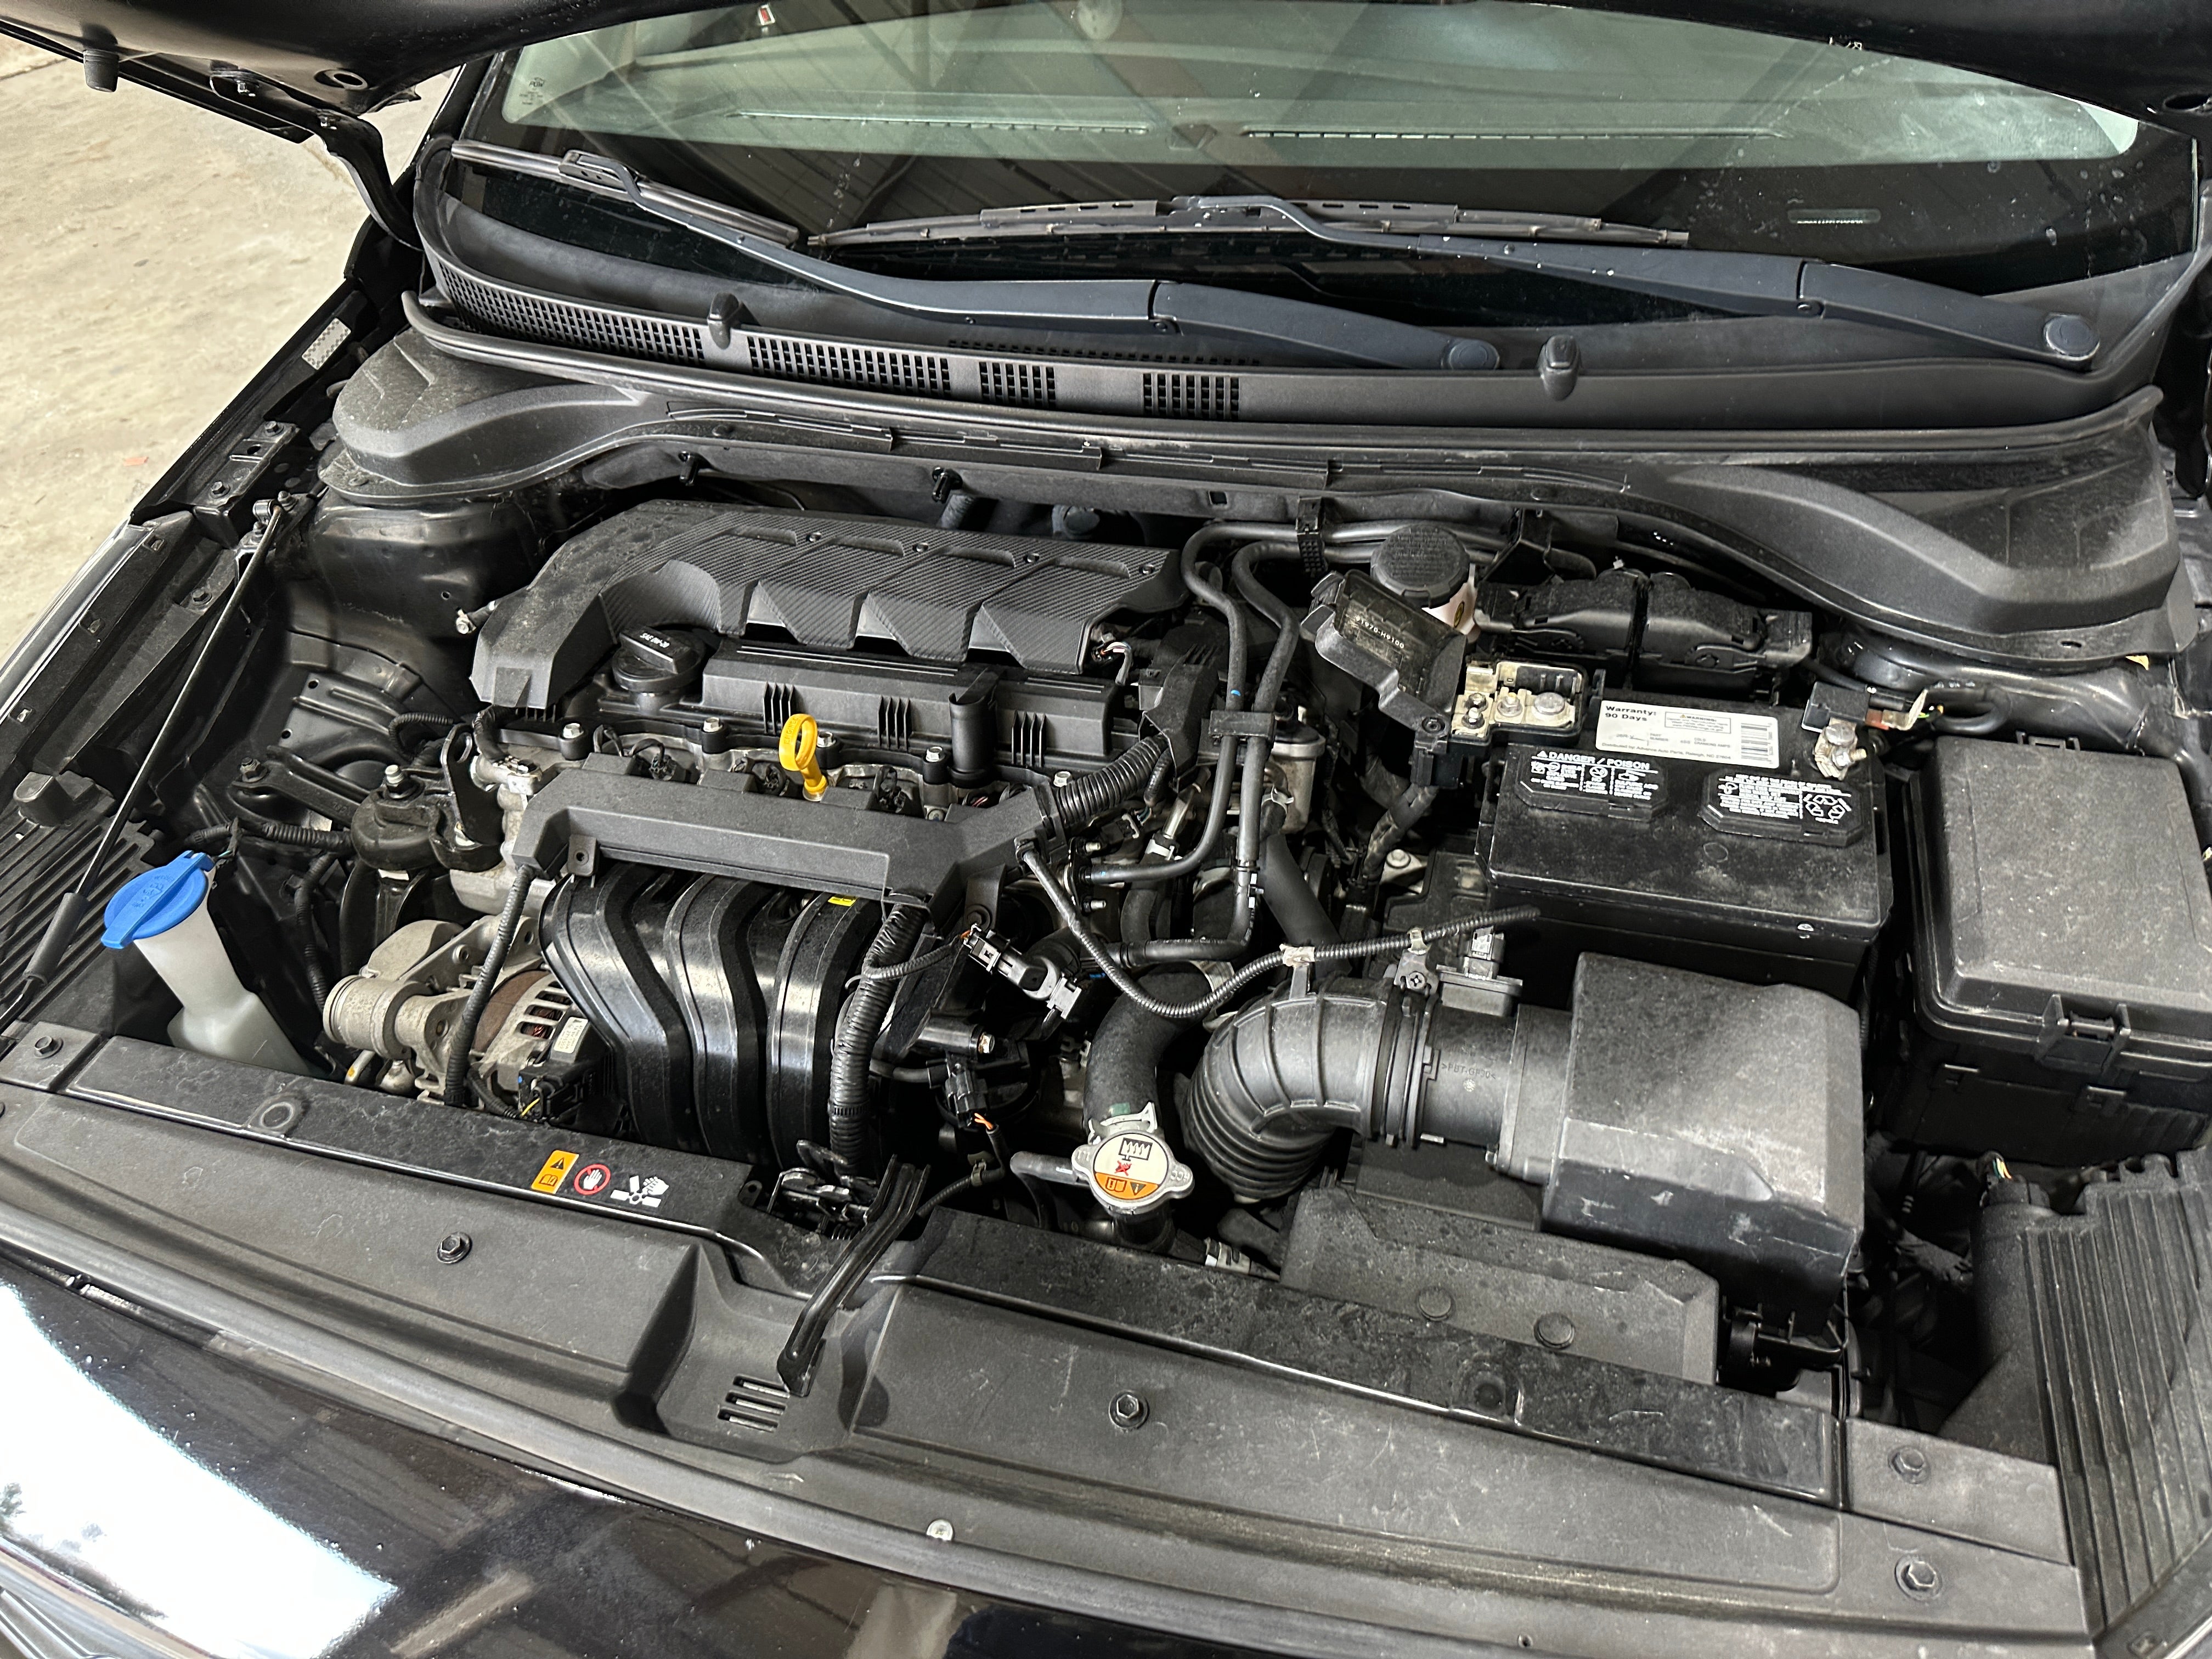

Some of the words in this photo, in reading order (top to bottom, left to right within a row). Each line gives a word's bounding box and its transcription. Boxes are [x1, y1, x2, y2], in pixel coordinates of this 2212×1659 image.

[1605, 706, 1657, 716] Warranty:
[1549, 752, 1595, 764] DANGER
[1607, 759, 1650, 770] POISON
